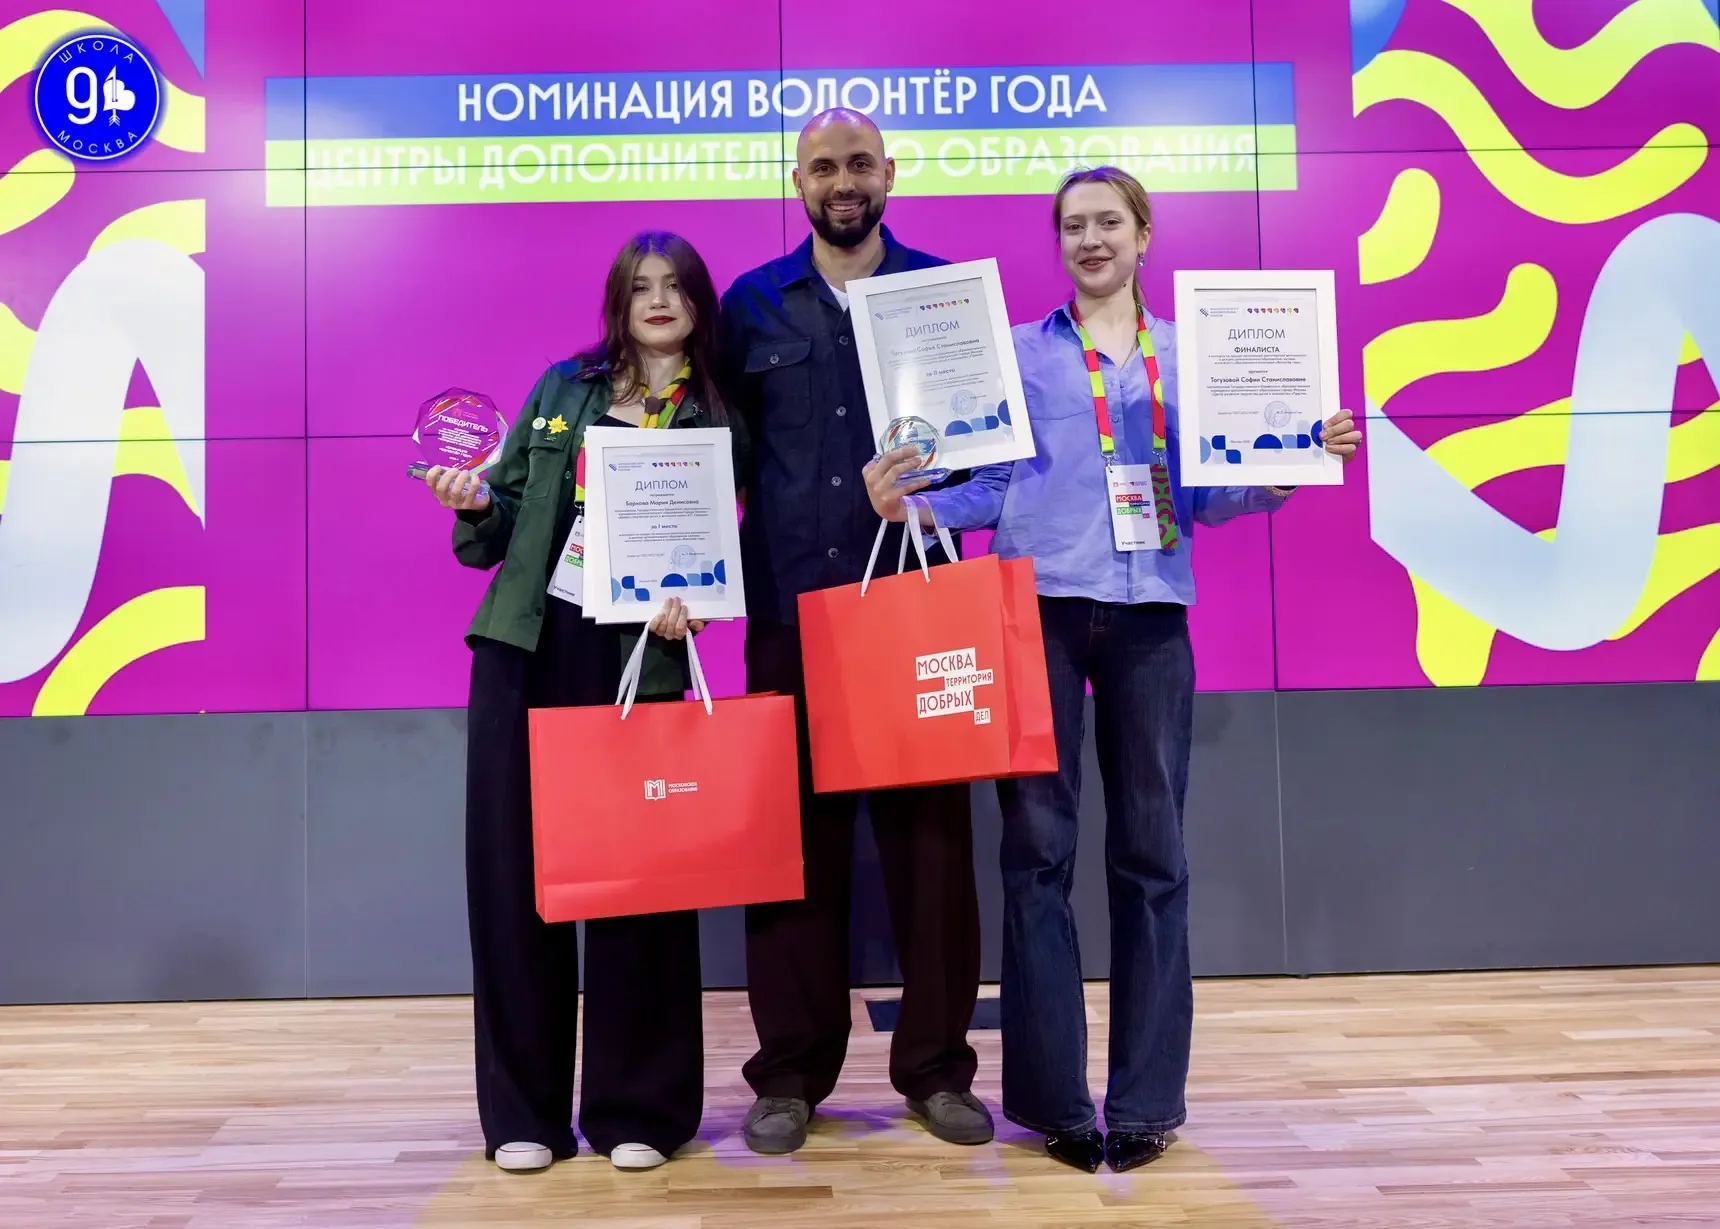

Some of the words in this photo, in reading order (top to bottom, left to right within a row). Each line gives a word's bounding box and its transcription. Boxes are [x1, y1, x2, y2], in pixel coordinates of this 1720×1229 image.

[458, 79, 733, 124] НОМИНАЦИЯ
[748, 69, 977, 118] ВОЛОНТЁР
[990, 74, 1108, 118] ГОДА
[307, 145, 466, 190] ЦЕНТРЫ
[937, 133, 1255, 177] ОБРАЗОВАНИЯ
[905, 320, 960, 338] ДИПЛОМ
[1228, 329, 1286, 340] ДИПЛОМ
[1210, 377, 1240, 385] Тогузовой
[438, 415, 488, 433] ПОБЕДИТЕЛЬ
[635, 480, 688, 491] ДИПЛОМ
[917, 653, 974, 677] МОСКВА
[946, 671, 992, 688] ТЕРРИТОРИЯ
[919, 690, 972, 715] ДОБРЫХ
[976, 710, 989, 722] ДЕЛ
